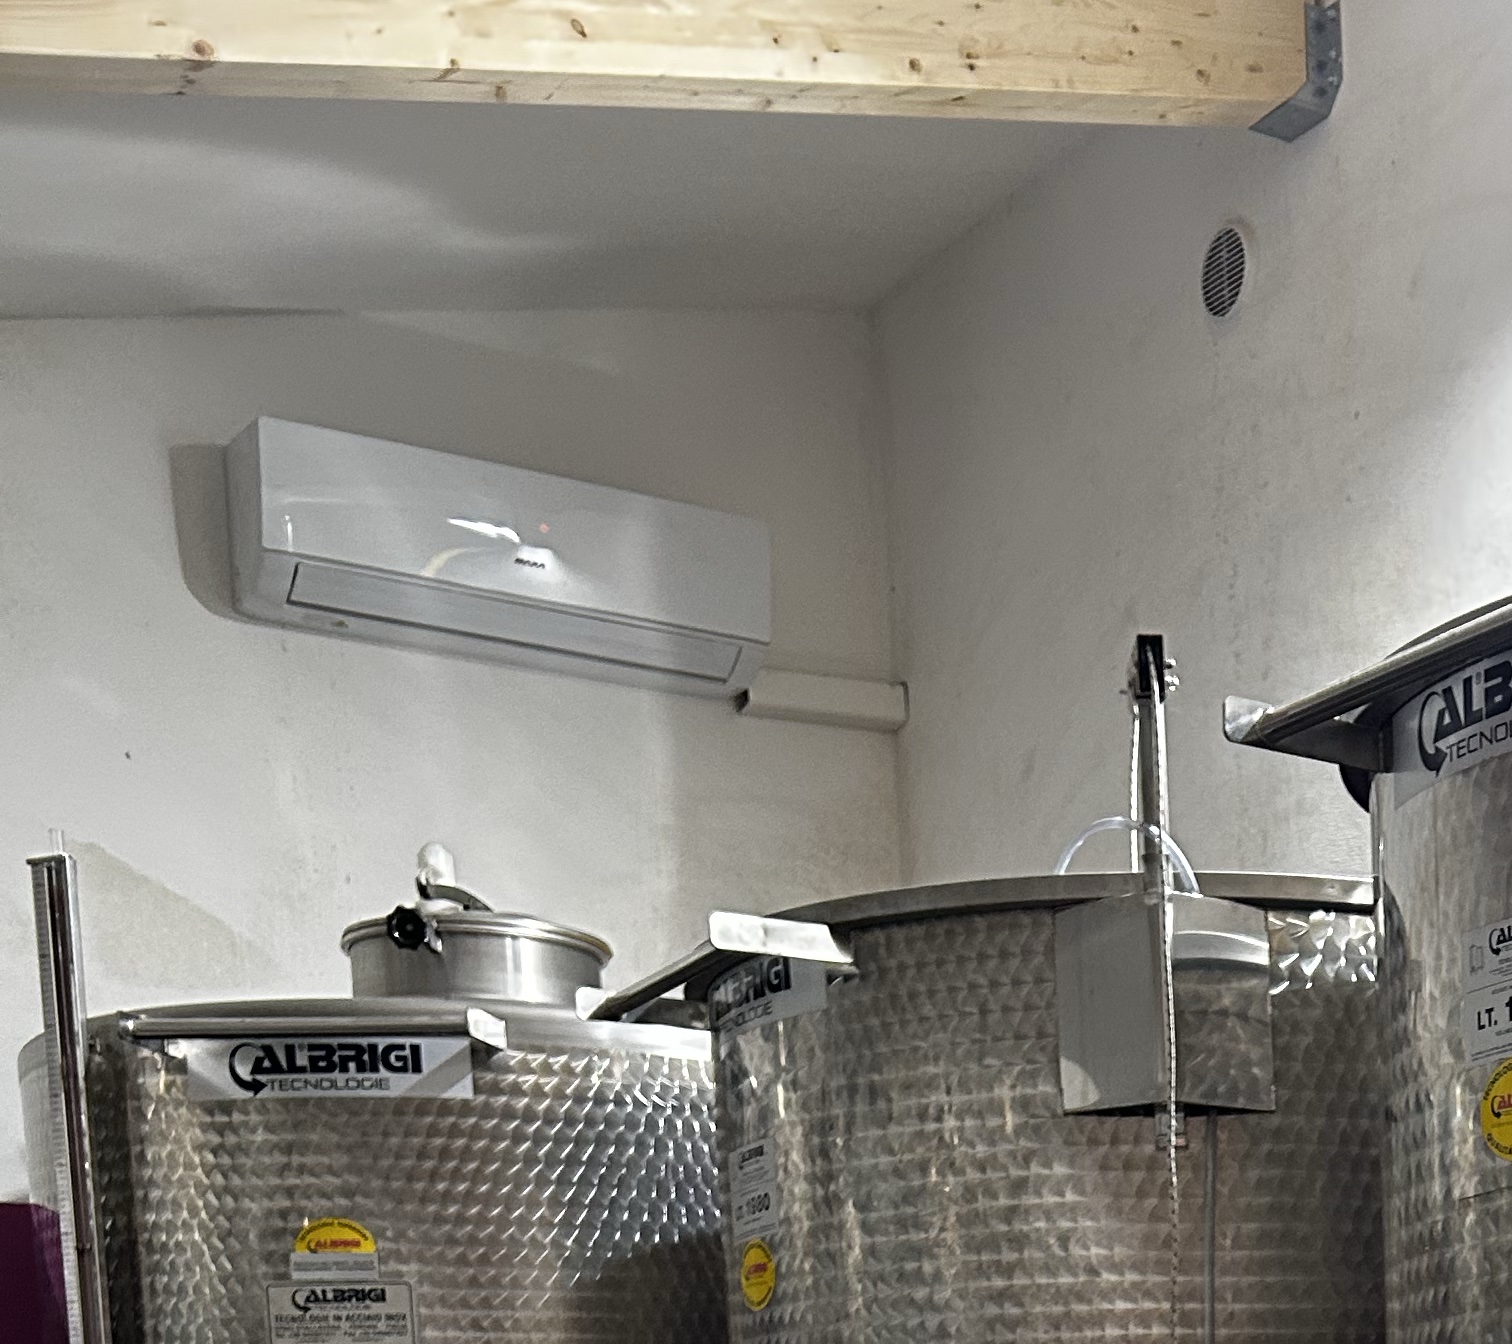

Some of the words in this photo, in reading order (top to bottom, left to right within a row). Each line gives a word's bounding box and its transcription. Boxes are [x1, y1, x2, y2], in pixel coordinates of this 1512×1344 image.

[1477, 1007, 1498, 1031] LT.
[250, 1043, 423, 1074] ALBRIGI
[266, 1077, 391, 1092] TECNOLOGIE
[304, 1287, 387, 1303] ALBRIGI
